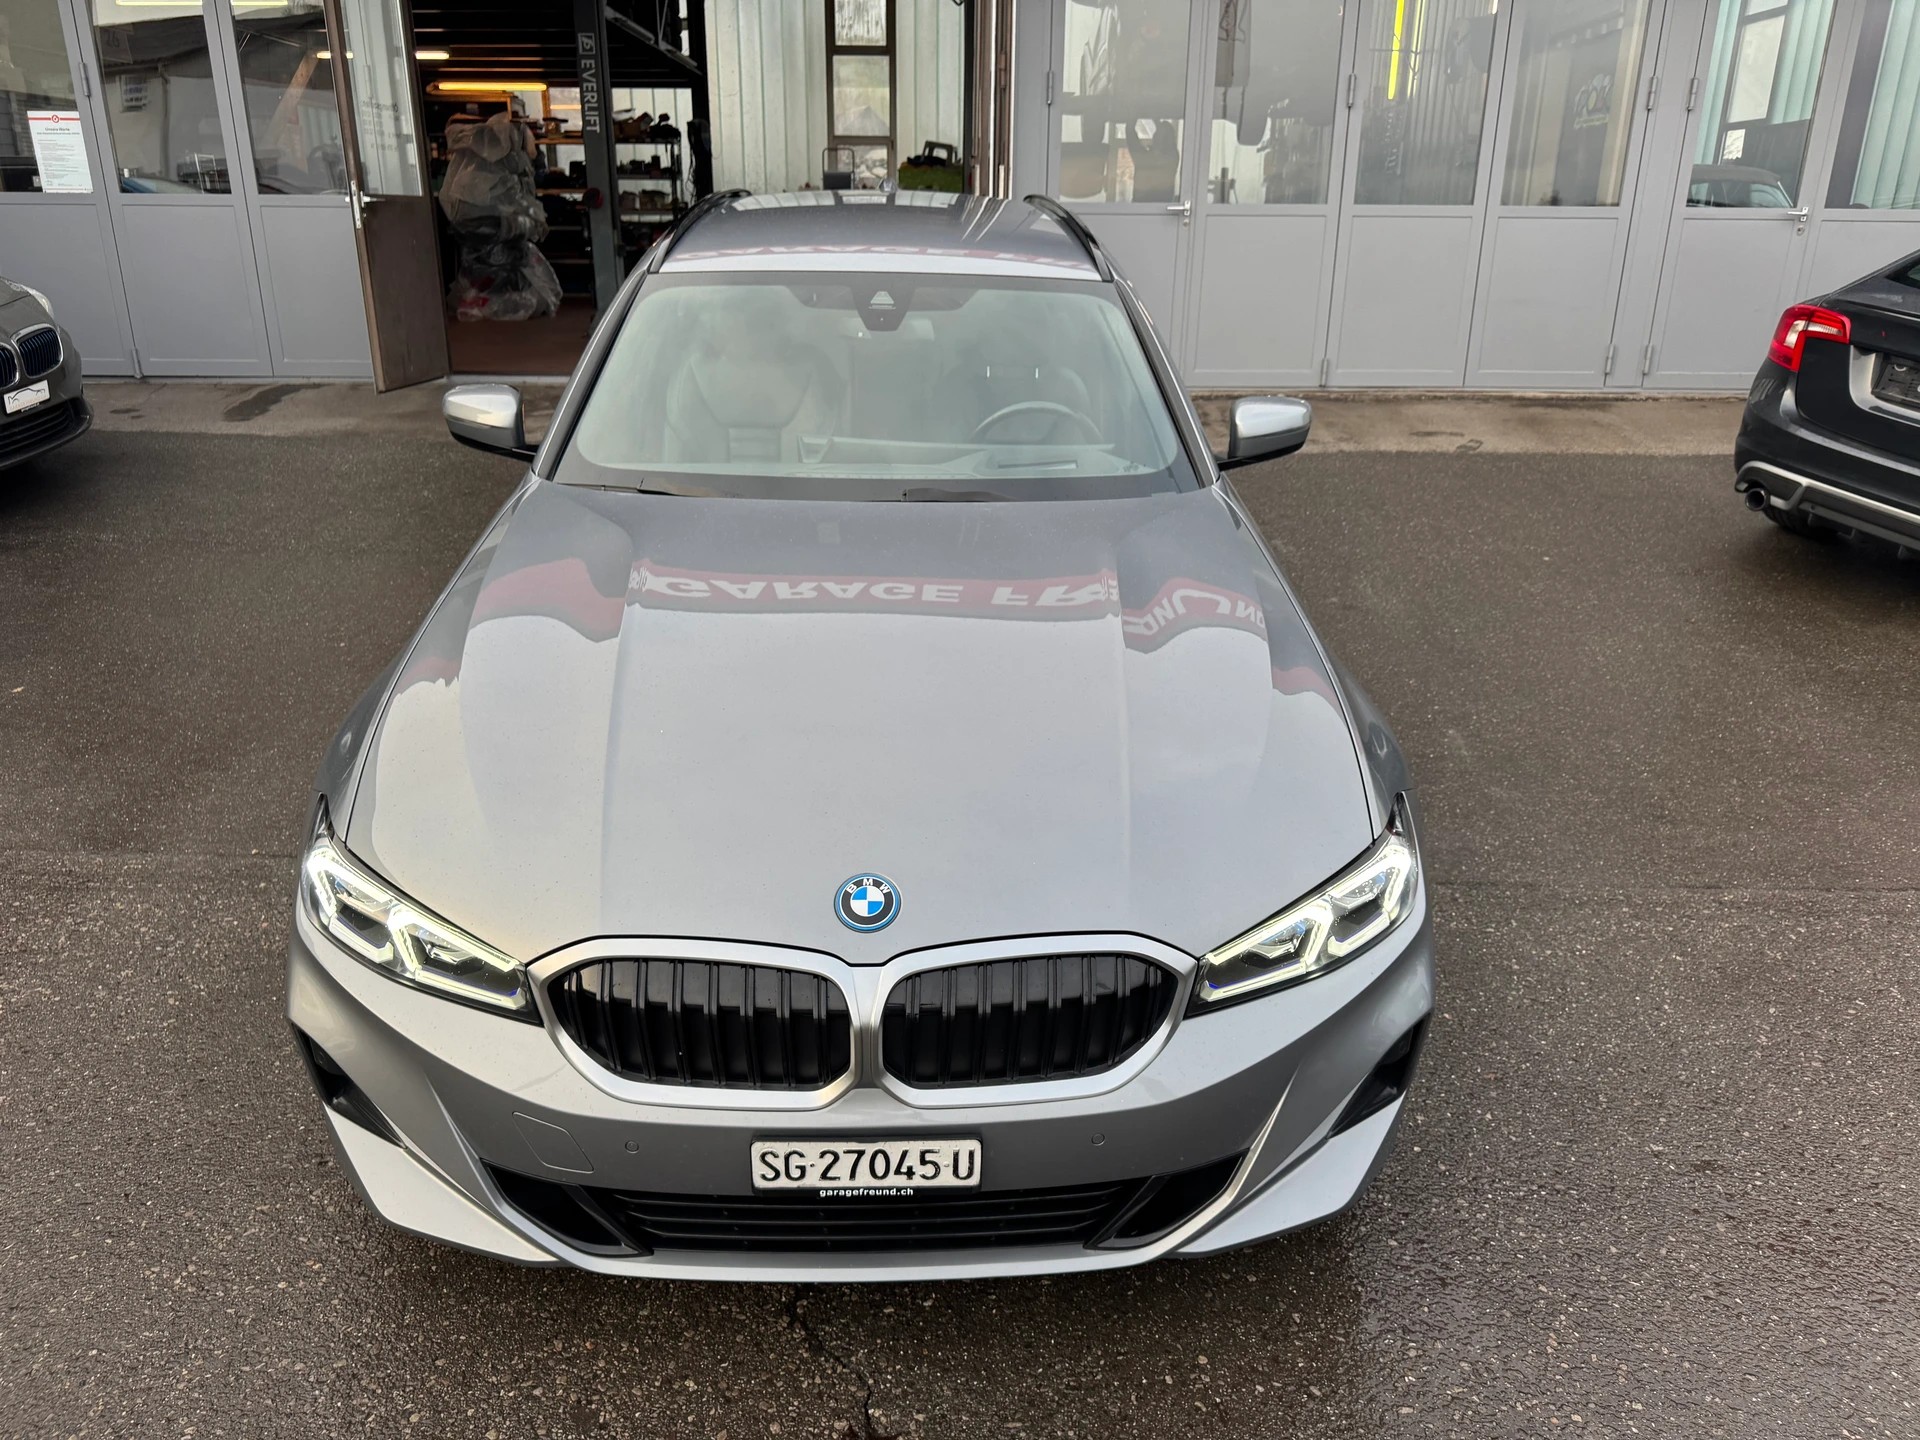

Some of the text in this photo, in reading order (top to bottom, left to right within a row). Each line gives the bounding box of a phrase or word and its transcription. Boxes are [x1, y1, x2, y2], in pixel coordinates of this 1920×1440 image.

[581, 59, 600, 133] EVERLIFT
[846, 878, 891, 894] BMW
[819, 1187, 914, 1198] garagefreund.ch
